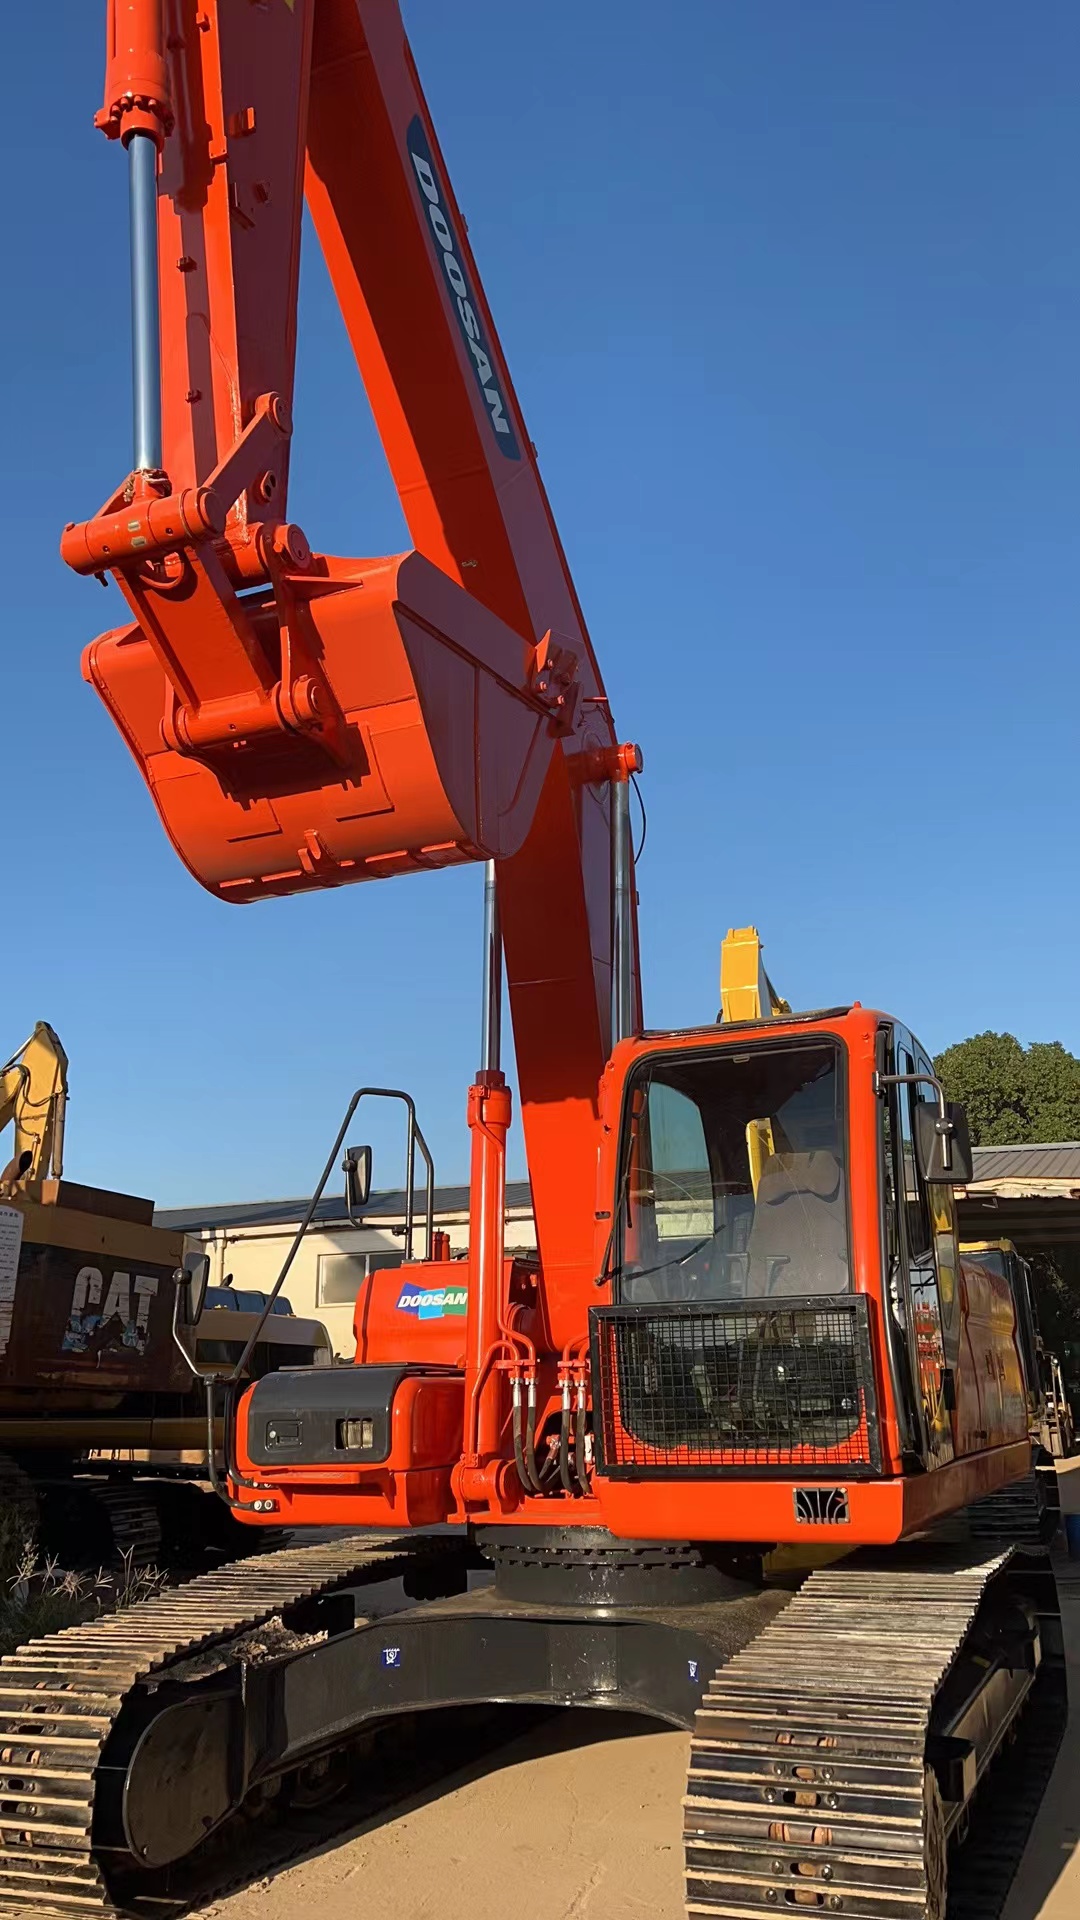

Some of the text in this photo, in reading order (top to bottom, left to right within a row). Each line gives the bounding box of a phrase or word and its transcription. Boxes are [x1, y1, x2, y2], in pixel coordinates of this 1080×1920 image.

[411, 152, 511, 433] DOOSAN
[62, 1266, 159, 1353] CAT
[397, 1292, 468, 1308] DOOSAN
